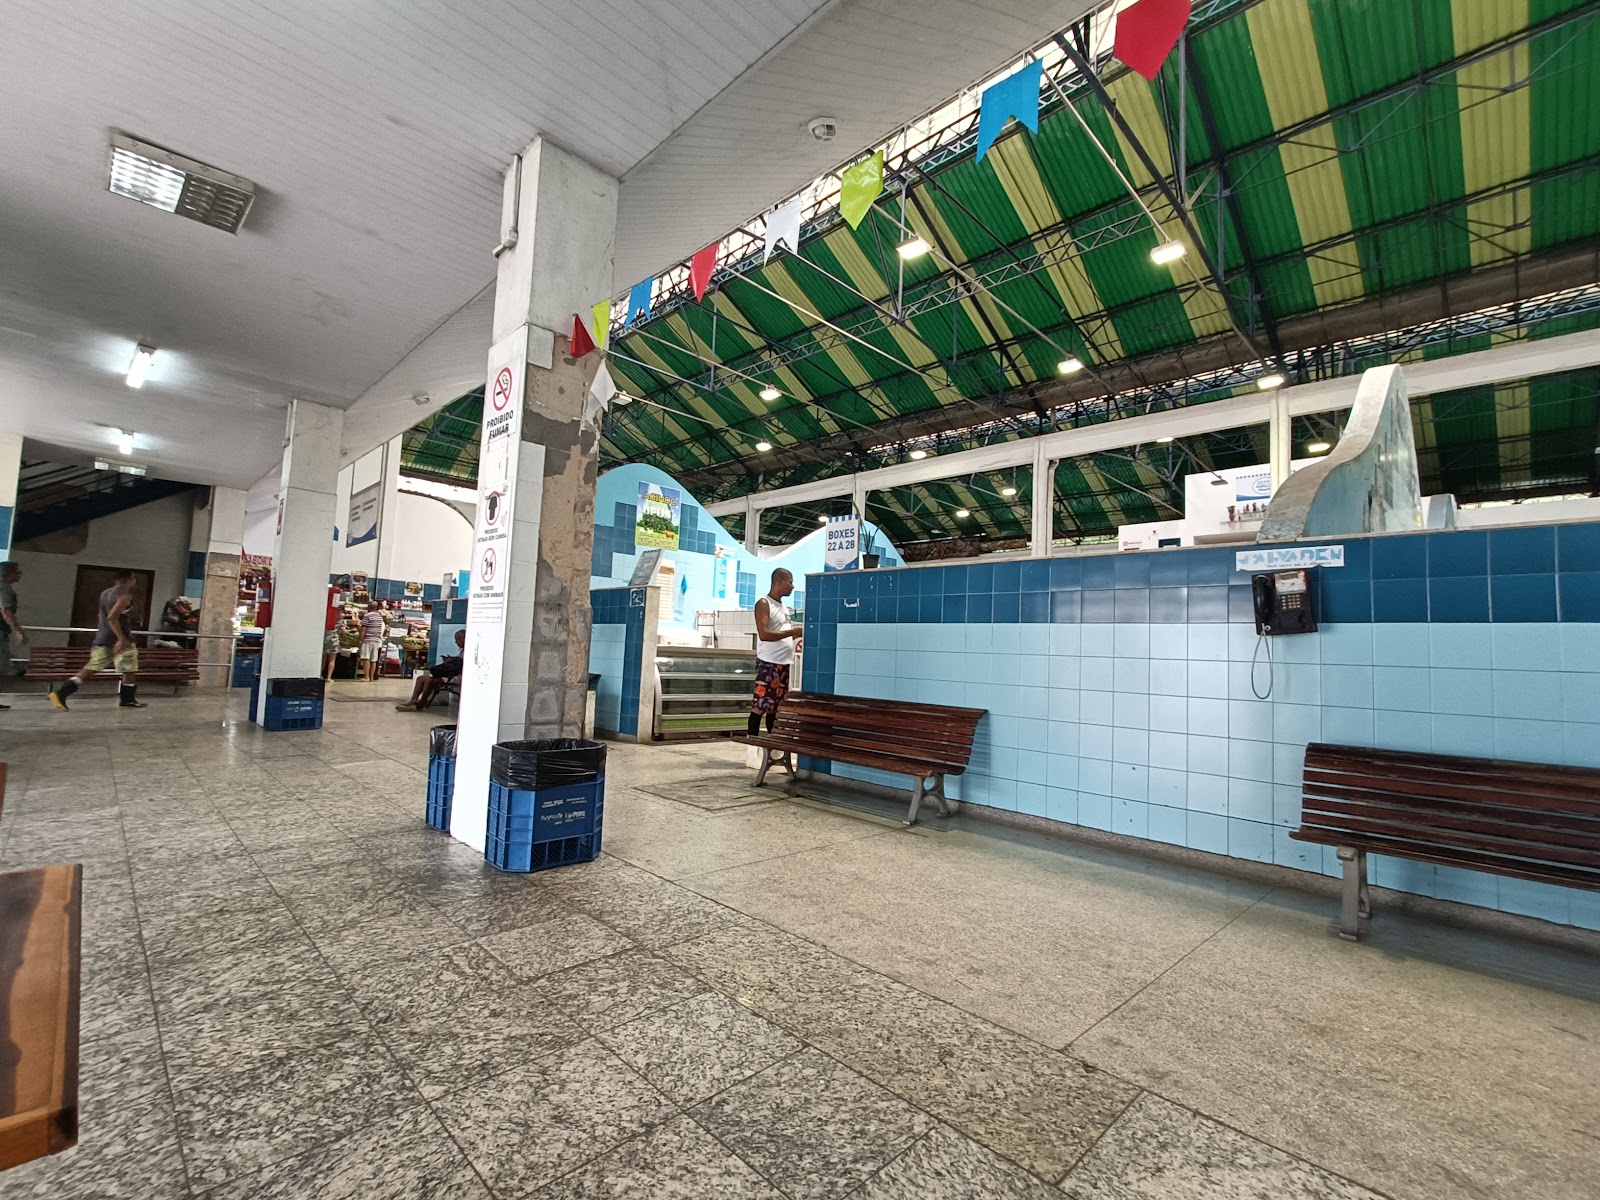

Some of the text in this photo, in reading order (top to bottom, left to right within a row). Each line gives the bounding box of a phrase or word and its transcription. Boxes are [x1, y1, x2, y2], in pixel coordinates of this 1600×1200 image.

[487, 410, 514, 429] PROIBIDO
[489, 423, 509, 439] FUMAR
[829, 528, 854, 540] BOXES
[828, 540, 855, 551] 22 A 28
